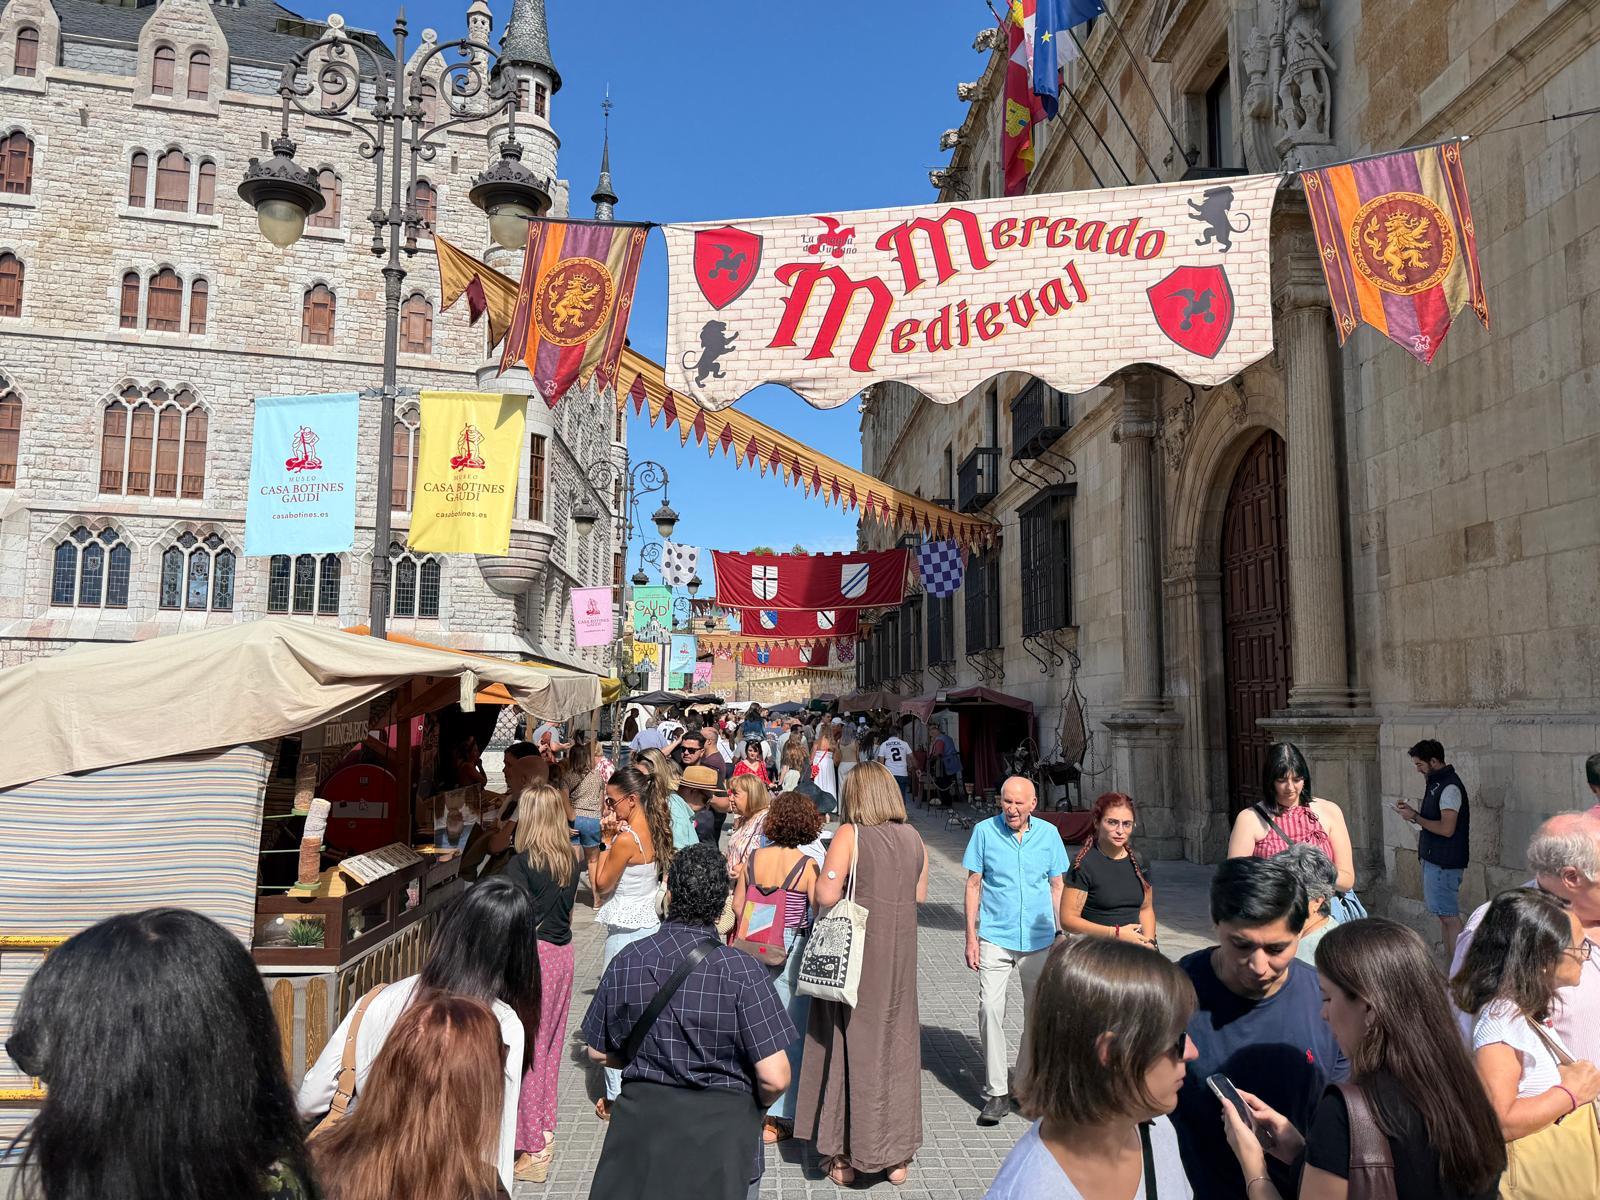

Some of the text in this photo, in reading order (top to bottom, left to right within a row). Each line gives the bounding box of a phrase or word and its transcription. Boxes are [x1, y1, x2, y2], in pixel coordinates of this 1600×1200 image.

[875, 207, 1168, 295] Mercado
[765, 260, 1089, 372] Medieval
[260, 482, 344, 496] CASA BOTINES
[423, 482, 505, 494] CASA BOTINES
[272, 511, 329, 520] casabotines.es
[435, 510, 488, 518] casabotines.es
[890, 747, 902, 762] 2
